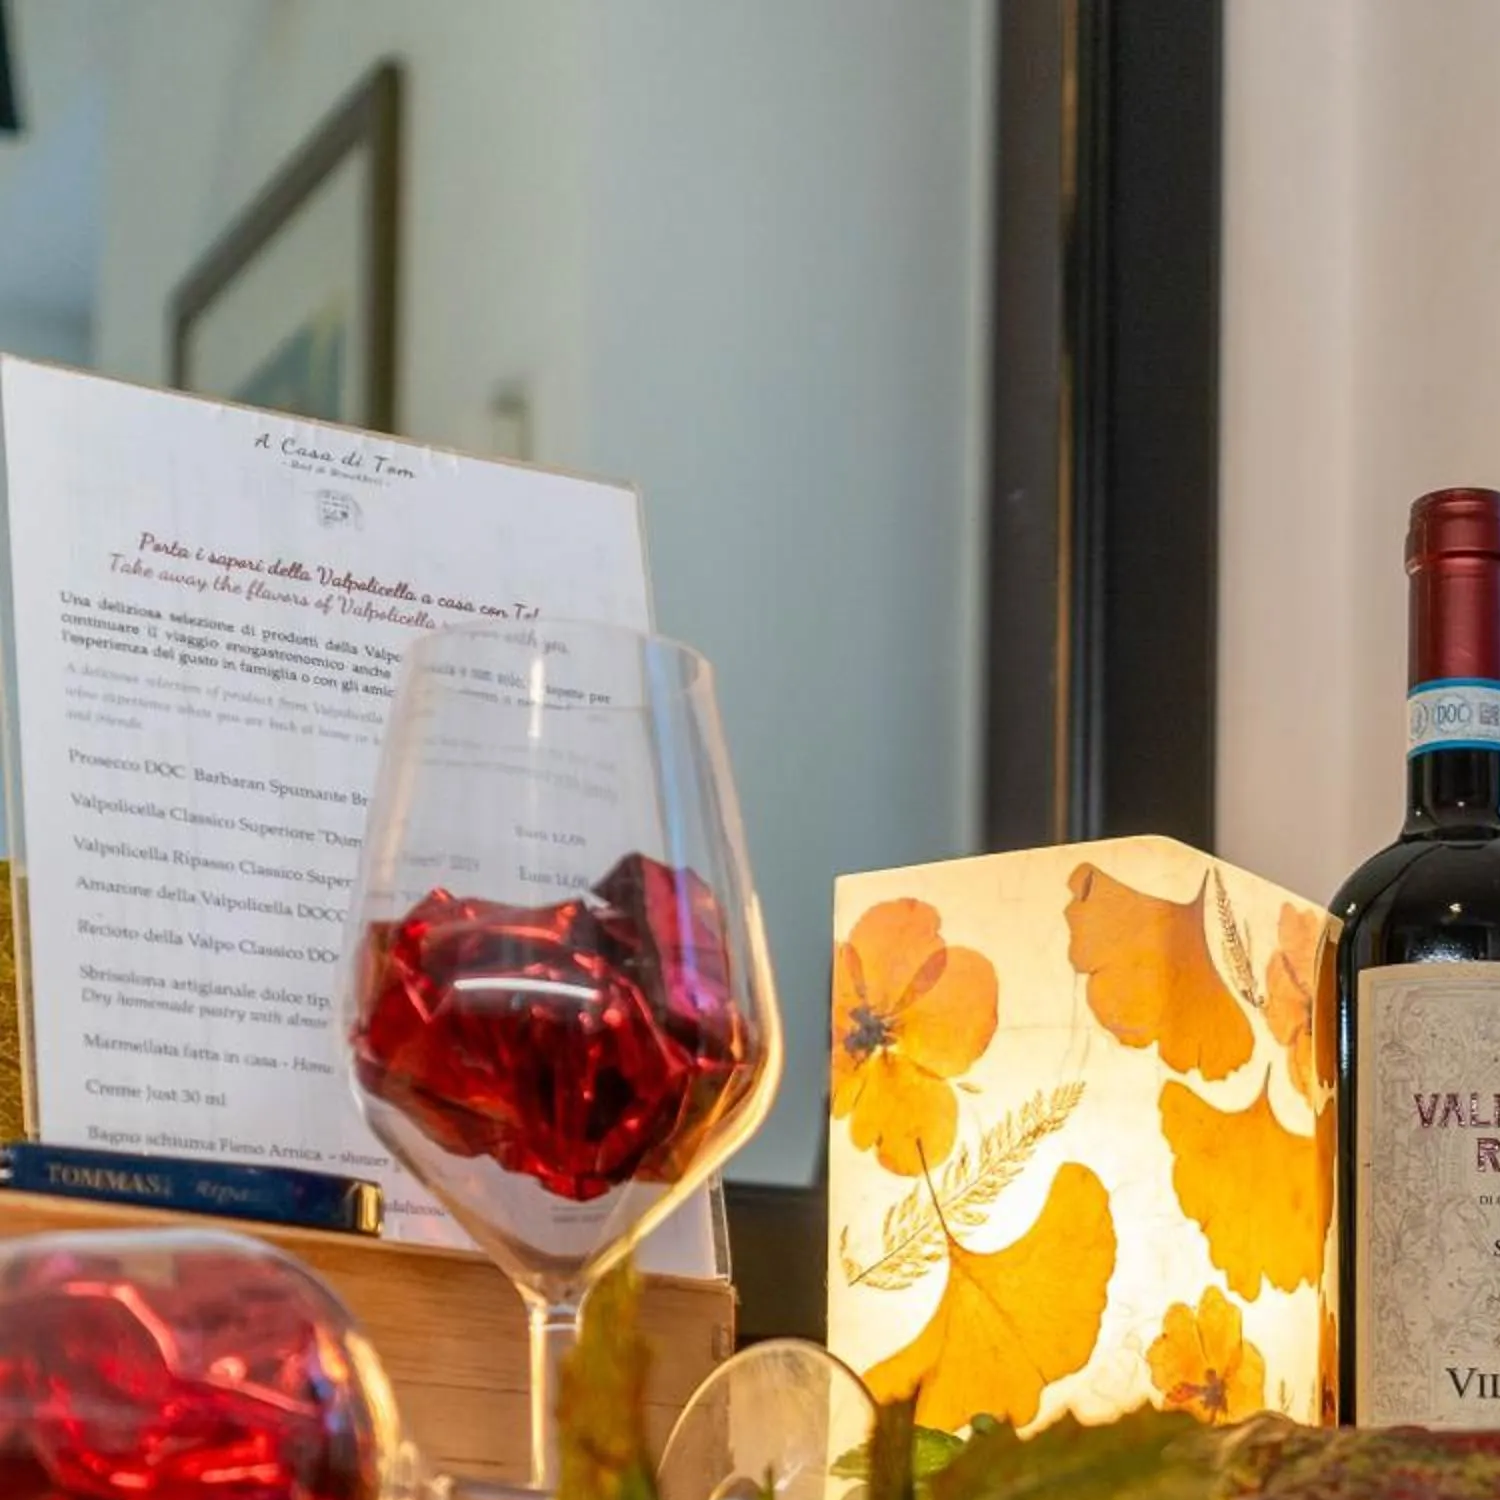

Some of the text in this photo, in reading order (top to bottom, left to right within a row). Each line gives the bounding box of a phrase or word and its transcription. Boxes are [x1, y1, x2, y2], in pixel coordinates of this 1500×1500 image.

[254, 433, 270, 449] A
[281, 437, 335, 461] Casa
[341, 451, 363, 467] di
[109, 552, 155, 579] Take
[158, 570, 208, 592] away
[213, 574, 244, 595] the
[246, 579, 311, 608] flavors
[314, 594, 334, 617] of
[337, 594, 437, 630] Valpolicella
[138, 531, 190, 560] Porta
[208, 552, 264, 574] sapori
[267, 559, 313, 582] della
[317, 565, 416, 602] Valpolicella
[421, 594, 433, 605] a
[437, 596, 476, 613] casa
[479, 604, 508, 619] con
[60, 590, 92, 608] Una
[99, 597, 163, 620] deliziosa
[169, 612, 235, 632] selezione
[241, 622, 256, 637] di
[262, 626, 319, 650] prodotti
[324, 638, 359, 656] della
[61, 613, 140, 636] continuare
[147, 623, 158, 637] il
[165, 630, 219, 651] viaggio
[226, 641, 346, 672] enogastronomico
[352, 663, 392, 680] anche
[153, 645, 176, 661] del
[178, 650, 219, 668] gusto
[222, 656, 238, 671] in
[240, 660, 298, 683] famiglia
[301, 673, 311, 683] o
[313, 675, 338, 688] con
[341, 678, 360, 693] gli
[69, 748, 141, 773] Prosecco
[144, 758, 188, 780] DOC
[193, 768, 266, 792] Barbaran
[269, 778, 348, 804] Spumante
[70, 792, 165, 820] Valpolicella
[169, 806, 236, 830] Classico
[239, 816, 316, 842] Superiore
[73, 835, 168, 863] Valpolicella
[173, 849, 236, 873] Ripasso
[239, 860, 303, 882] Classico
[77, 875, 154, 897] Amarone
[157, 884, 196, 903] della
[200, 891, 293, 917] Valpolicella
[143, 928, 184, 946] della
[188, 934, 236, 955] Valpo
[239, 938, 304, 960] Classico
[81, 988, 113, 1007] Dry
[116, 991, 197, 1015] homemade
[249, 1008, 283, 1026] with
[171, 976, 257, 999] artigianale
[260, 987, 303, 1005] dolce
[82, 1033, 180, 1059] Marmellata
[183, 1043, 220, 1064] fatta
[223, 1050, 240, 1065] in
[244, 1055, 279, 1070] casa
[85, 1078, 143, 1100] Creme
[145, 1083, 179, 1102] Just
[181, 1088, 201, 1103] 30
[87, 1125, 142, 1147] Bagno
[146, 1131, 217, 1152] schiuma
[1479, 1195, 1494, 1206] DI
